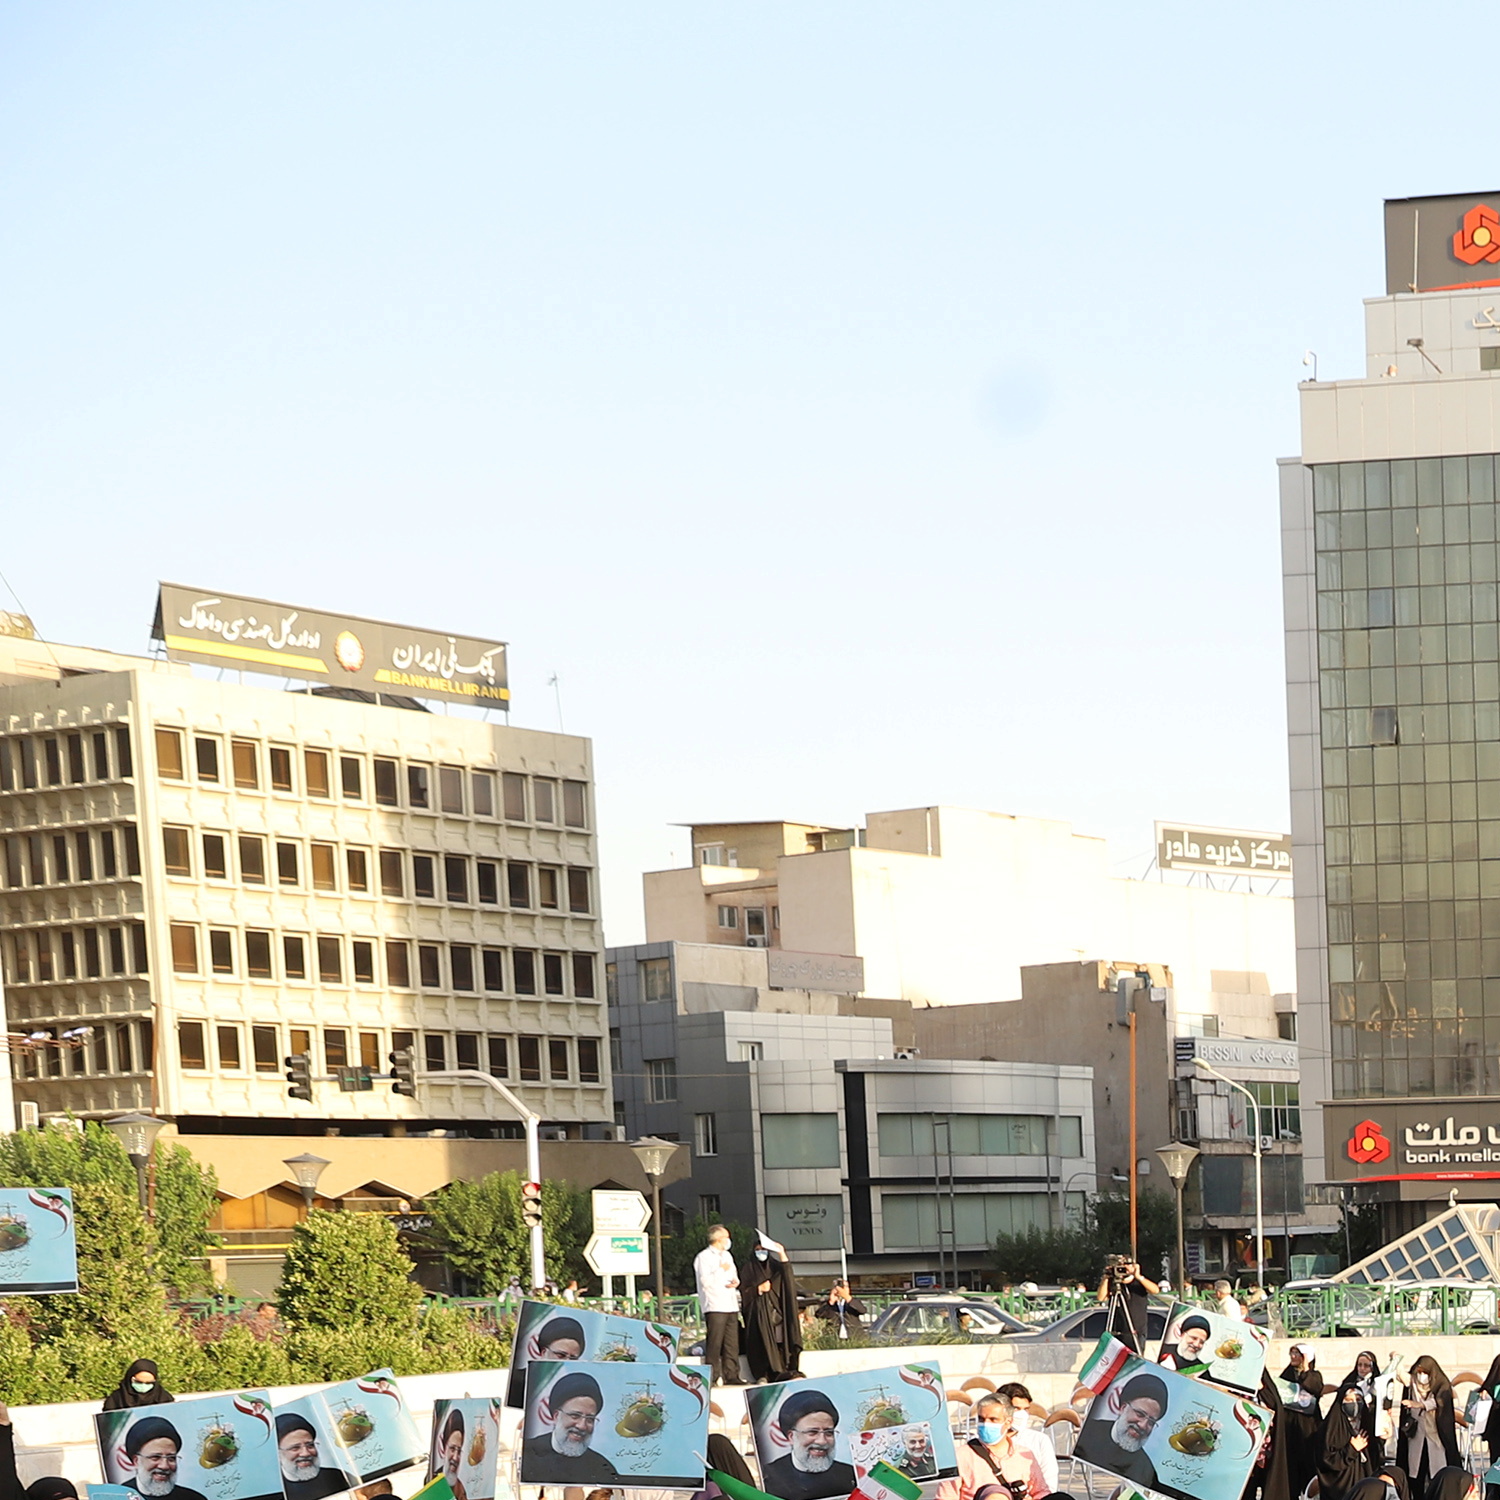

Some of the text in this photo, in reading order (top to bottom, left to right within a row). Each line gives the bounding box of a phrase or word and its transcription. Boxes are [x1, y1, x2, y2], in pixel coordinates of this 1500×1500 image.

[392, 644, 442, 674] ایران
[1164, 835, 1291, 870] مرکز خرید مادر
[1405, 1116, 1482, 1147] ملت
[1405, 1149, 1450, 1164] bank
[786, 1206, 828, 1221] ونوس
[791, 1226, 823, 1236] VENUS
